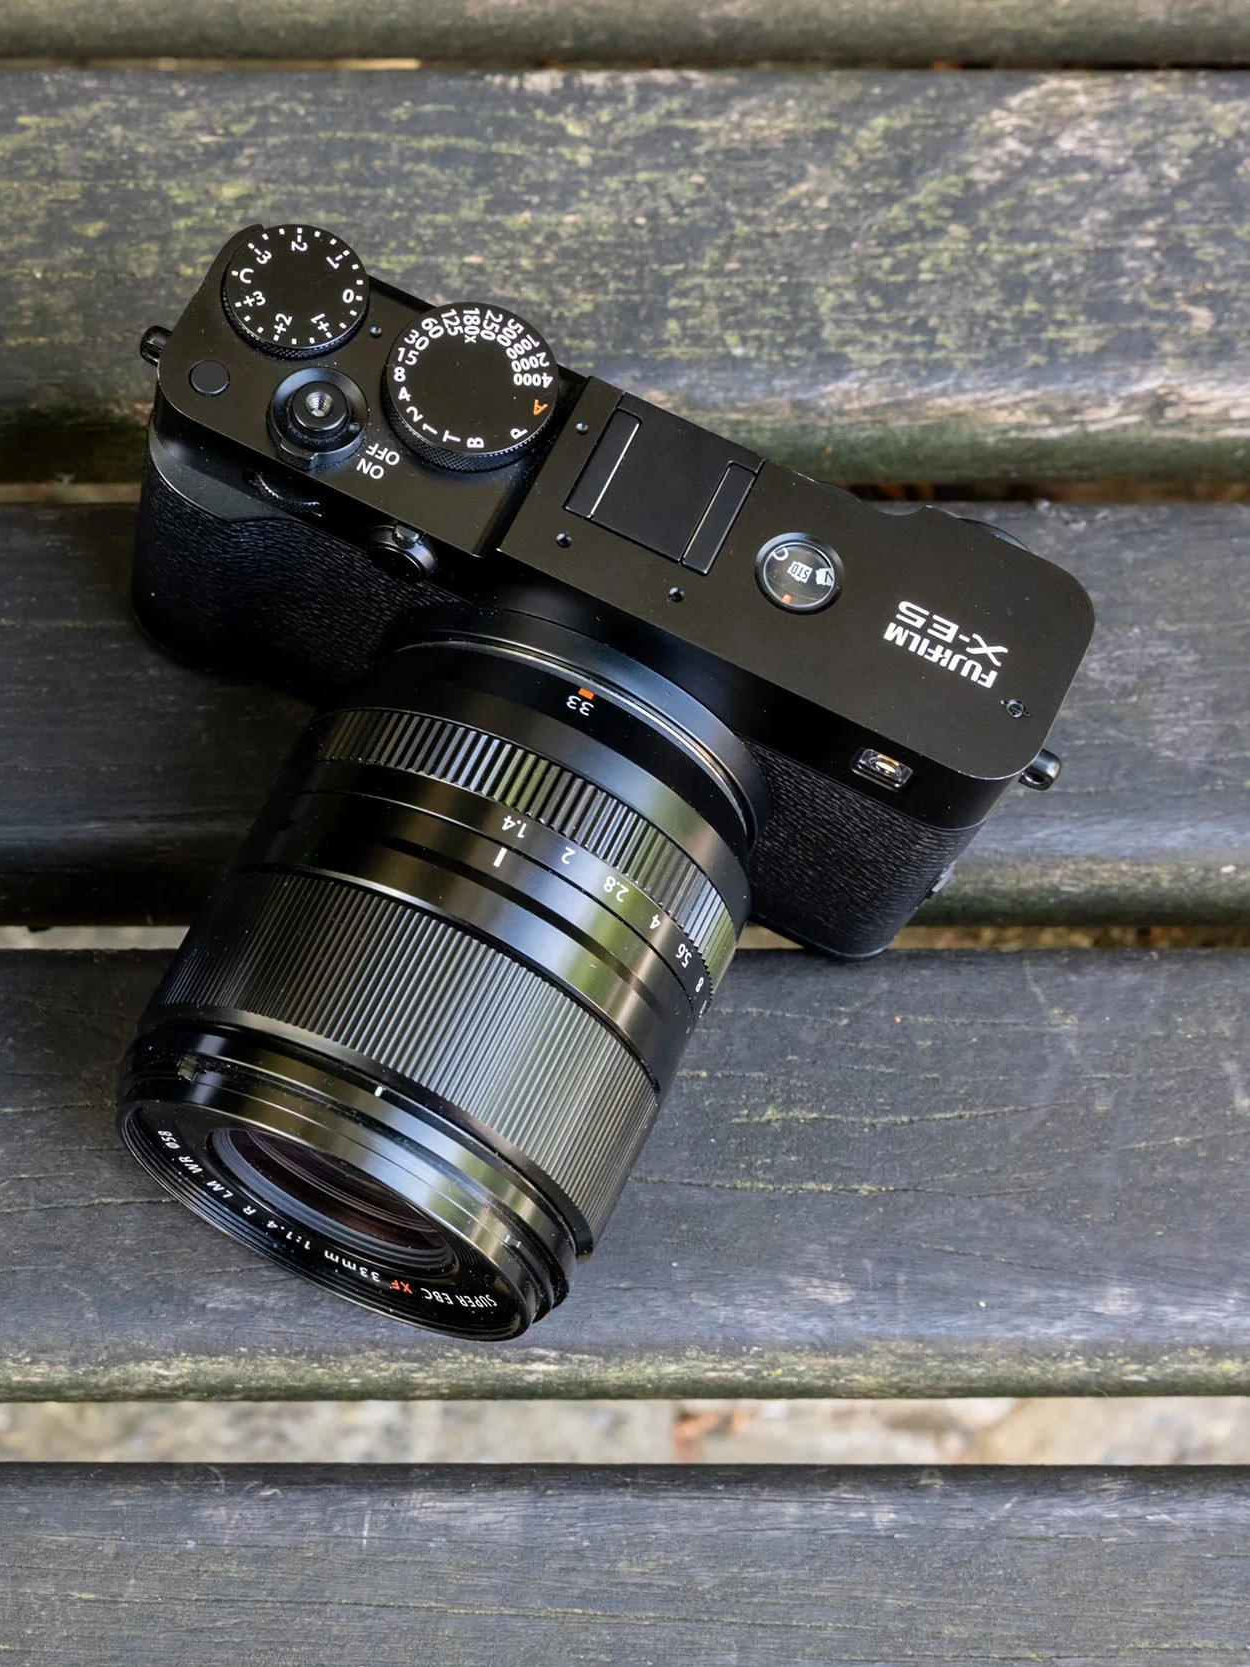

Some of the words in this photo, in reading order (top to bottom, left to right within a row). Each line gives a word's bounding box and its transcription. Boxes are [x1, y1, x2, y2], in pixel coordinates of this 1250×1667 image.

[239, 267, 254, 284] C
[243, 290, 266, 307] +3
[342, 288, 355, 304] 0
[273, 313, 293, 334] +2
[310, 313, 330, 332] +1
[421, 317, 444, 339] 60
[440, 308, 464, 336] 125
[462, 307, 481, 344] 180x
[480, 309, 503, 341] 250
[403, 329, 430, 351] 30
[496, 318, 524, 347] 500
[397, 347, 420, 365] 15
[505, 334, 540, 360] 1000
[511, 352, 550, 373] 2000
[393, 366, 406, 382] 8
[513, 372, 553, 388] 4000
[398, 386, 411, 402] 4
[406, 406, 423, 423] 2
[533, 399, 548, 415] A
[422, 422, 438, 435] 1
[442, 430, 461, 443] T
[510, 427, 528, 440] P
[466, 437, 485, 448] B
[365, 443, 400, 466] OFF
[356, 458, 385, 480] ON
[789, 562, 812, 581] STD
[897, 601, 1009, 667] X-E5
[883, 622, 998, 689] FUJIFILM
[566, 695, 595, 716] 33
[501, 815, 526, 839] 1.4
[561, 847, 576, 865] 2
[603, 875, 629, 903] 2.8
[649, 913, 661, 930] 4
[695, 976, 705, 993] 8
[178, 1155, 203, 1174] WR
[206, 1179, 234, 1199] LM
[242, 1205, 257, 1216] R
[266, 1219, 311, 1250] 1:1.4
[323, 1249, 381, 1283] 33mm
[391, 1279, 413, 1295] XF
[420, 1287, 455, 1306] EBC
[455, 1294, 498, 1308] SUPER
